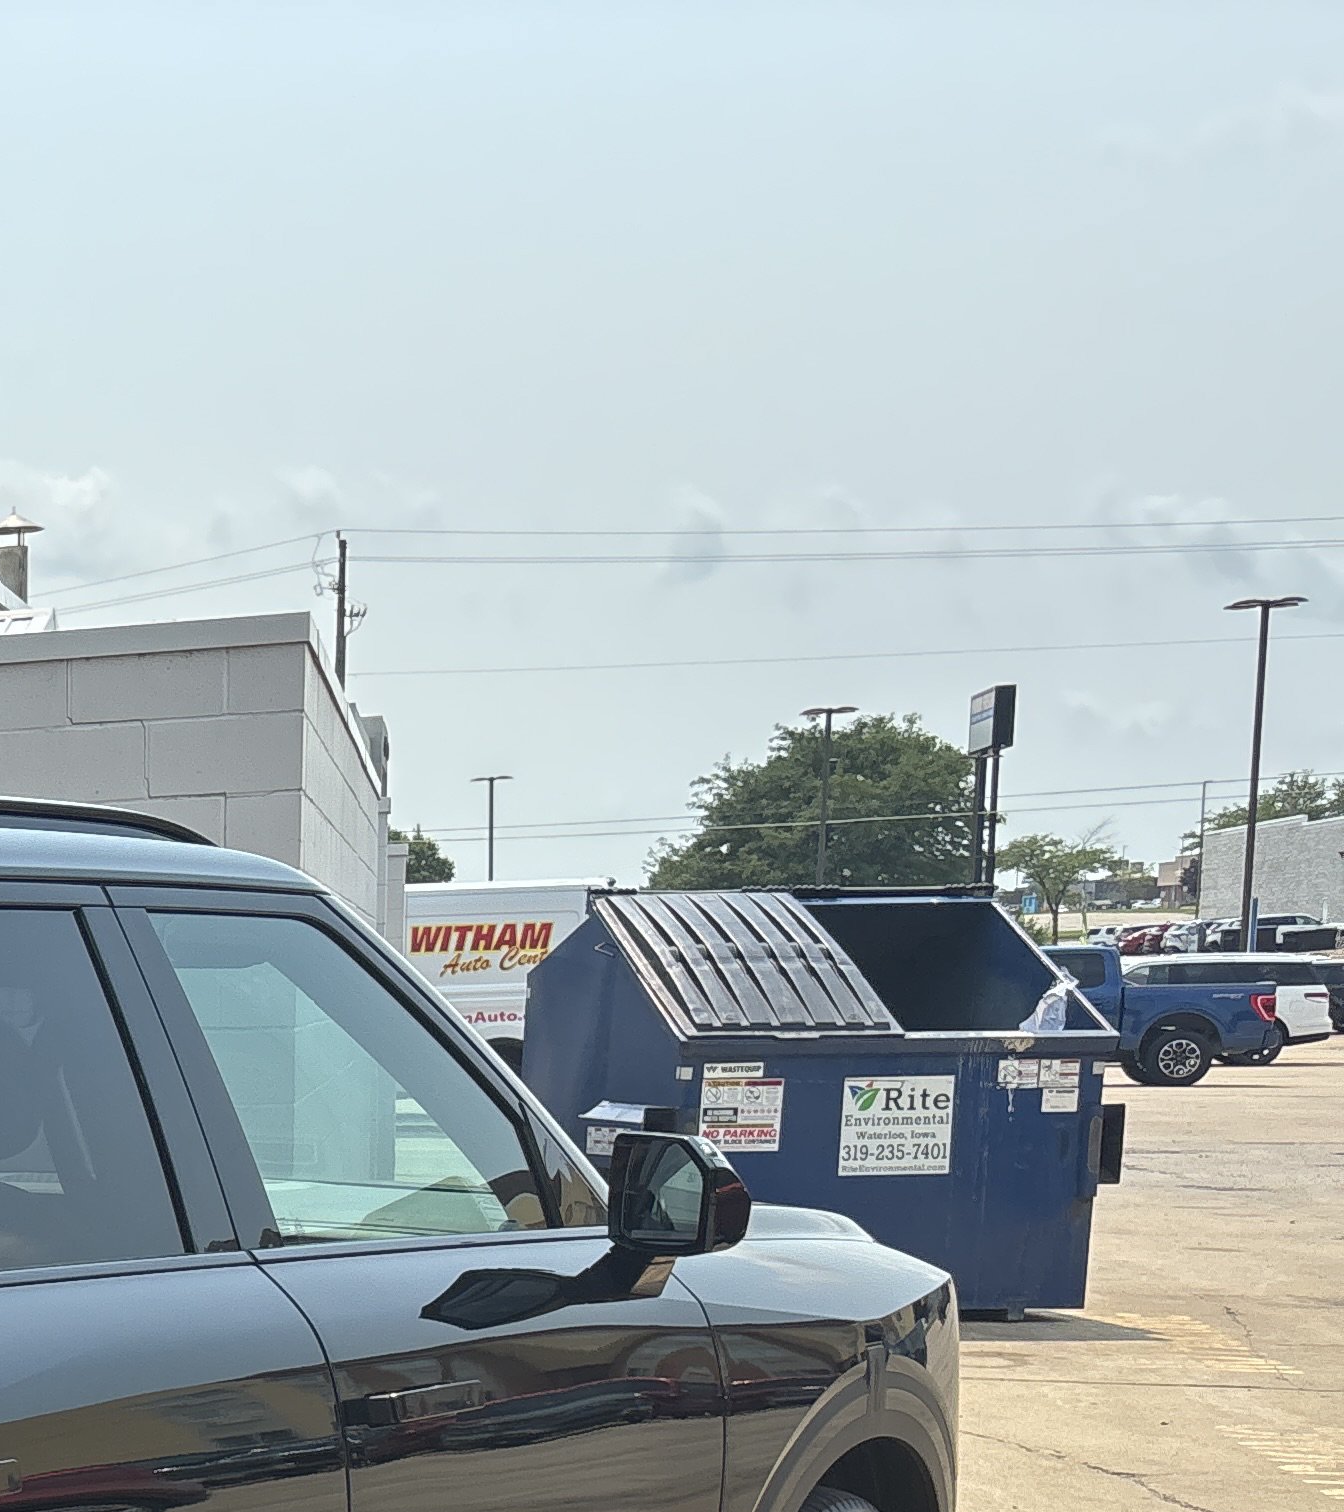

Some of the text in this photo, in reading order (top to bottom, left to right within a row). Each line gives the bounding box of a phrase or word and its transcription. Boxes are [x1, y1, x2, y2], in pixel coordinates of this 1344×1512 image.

[410, 921, 554, 954] WITHAM
[440, 953, 491, 977] Auto
[881, 1087, 951, 1111] Rite
[844, 1112, 950, 1127] Environmental
[702, 1129, 778, 1139] NO PARKING
[856, 1130, 937, 1141] Waterloo, Iowa
[841, 1142, 948, 1162] 319-235-7401
